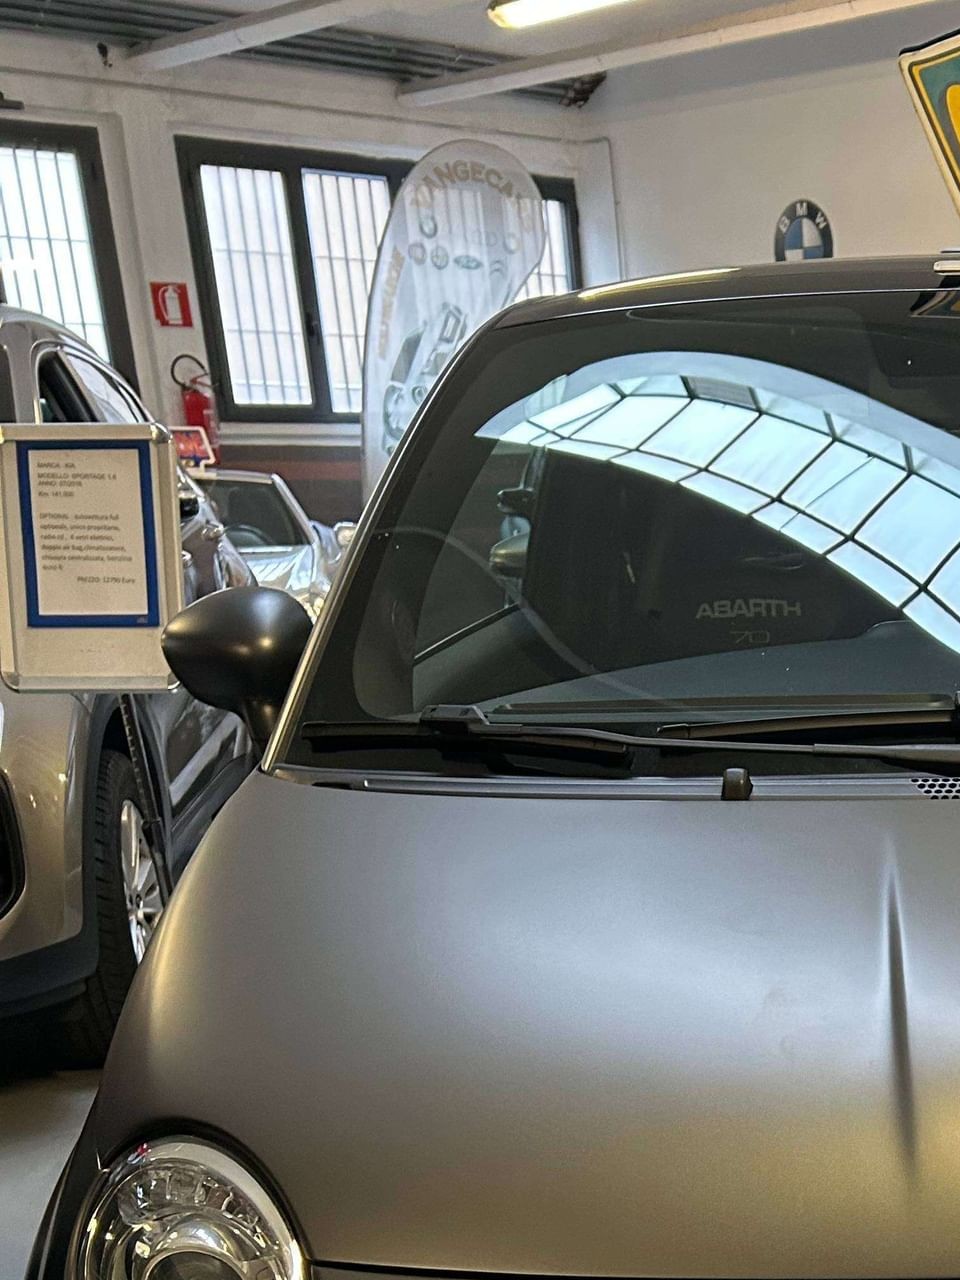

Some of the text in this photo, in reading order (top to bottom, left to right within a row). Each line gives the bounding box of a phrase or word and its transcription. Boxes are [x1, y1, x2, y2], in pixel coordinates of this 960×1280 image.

[411, 158, 533, 234] ANGECA
[779, 202, 827, 233] BMW
[695, 598, 801, 619] ABARTH
